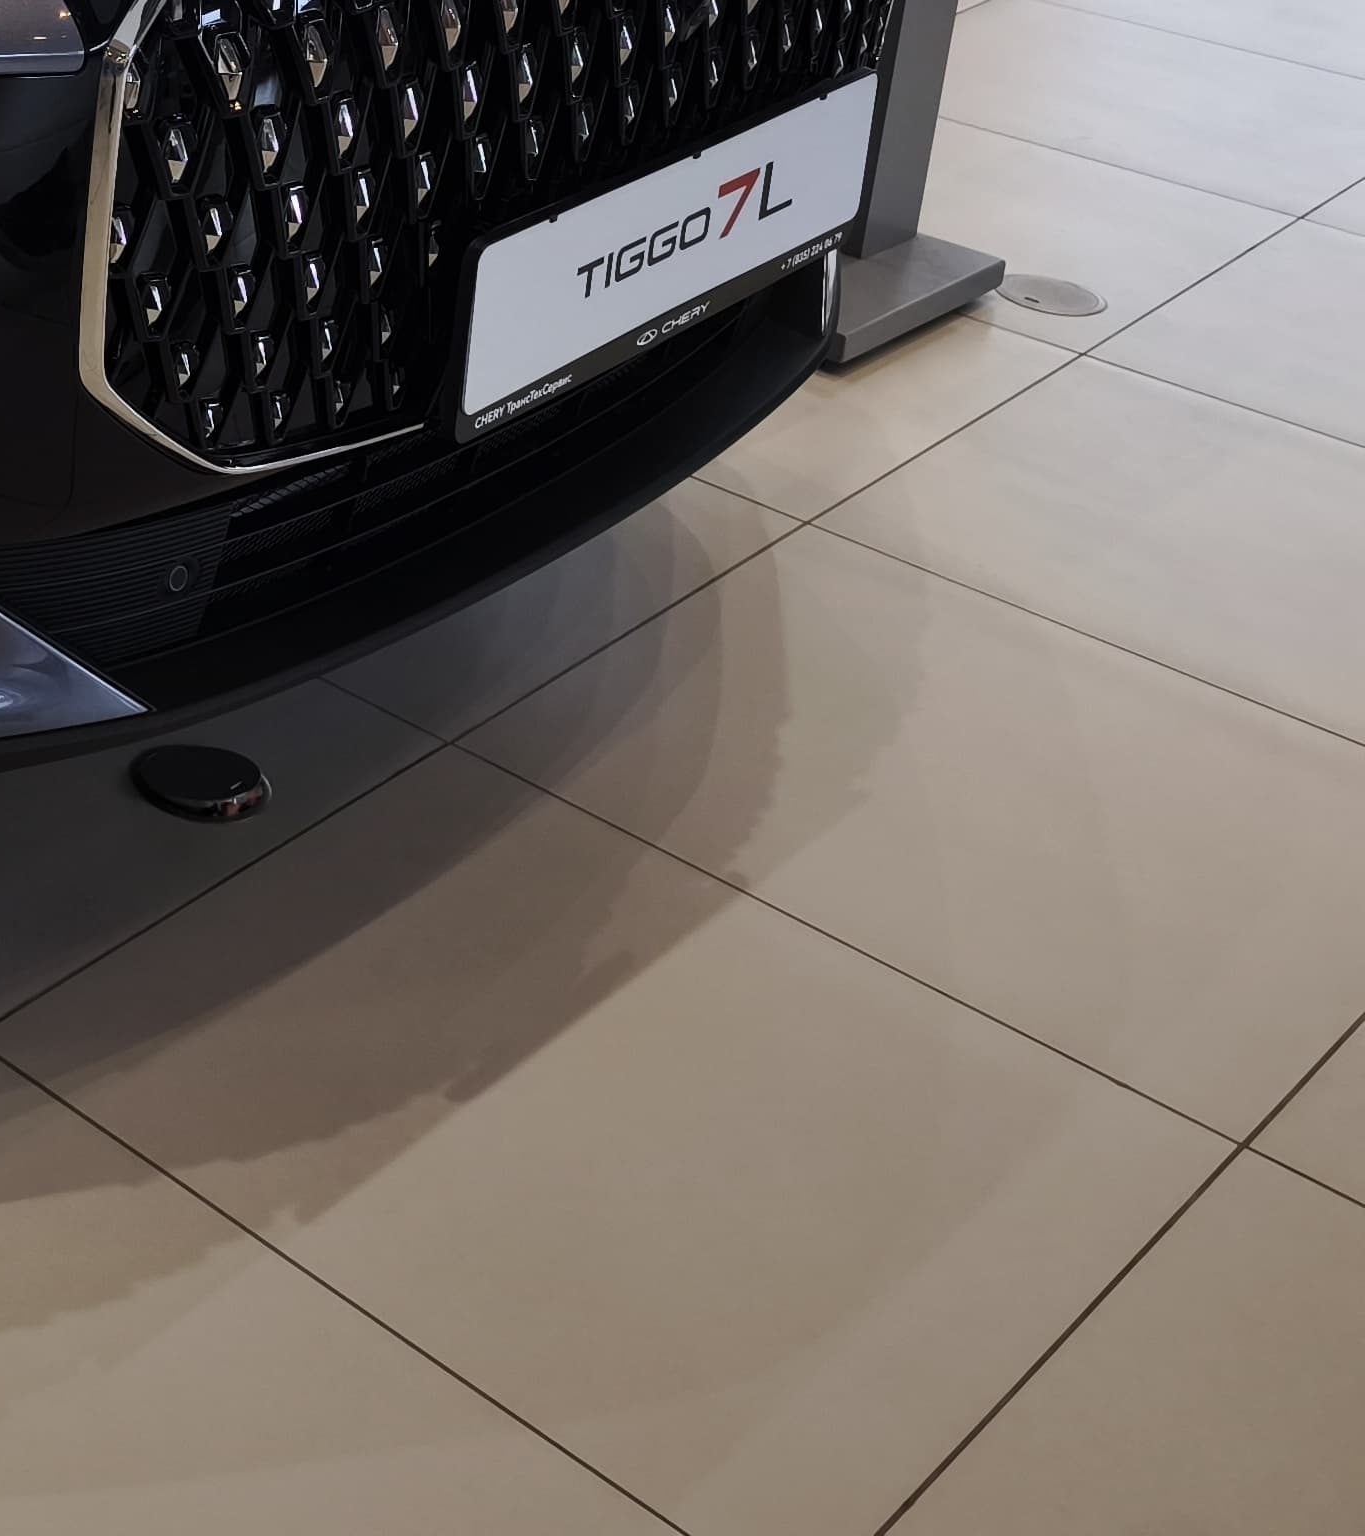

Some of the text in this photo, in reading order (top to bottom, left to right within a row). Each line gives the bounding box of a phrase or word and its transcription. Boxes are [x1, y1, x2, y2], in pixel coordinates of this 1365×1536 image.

[661, 301, 711, 334] CHERY
[474, 373, 573, 429] CHERY ТрансТехСервис
